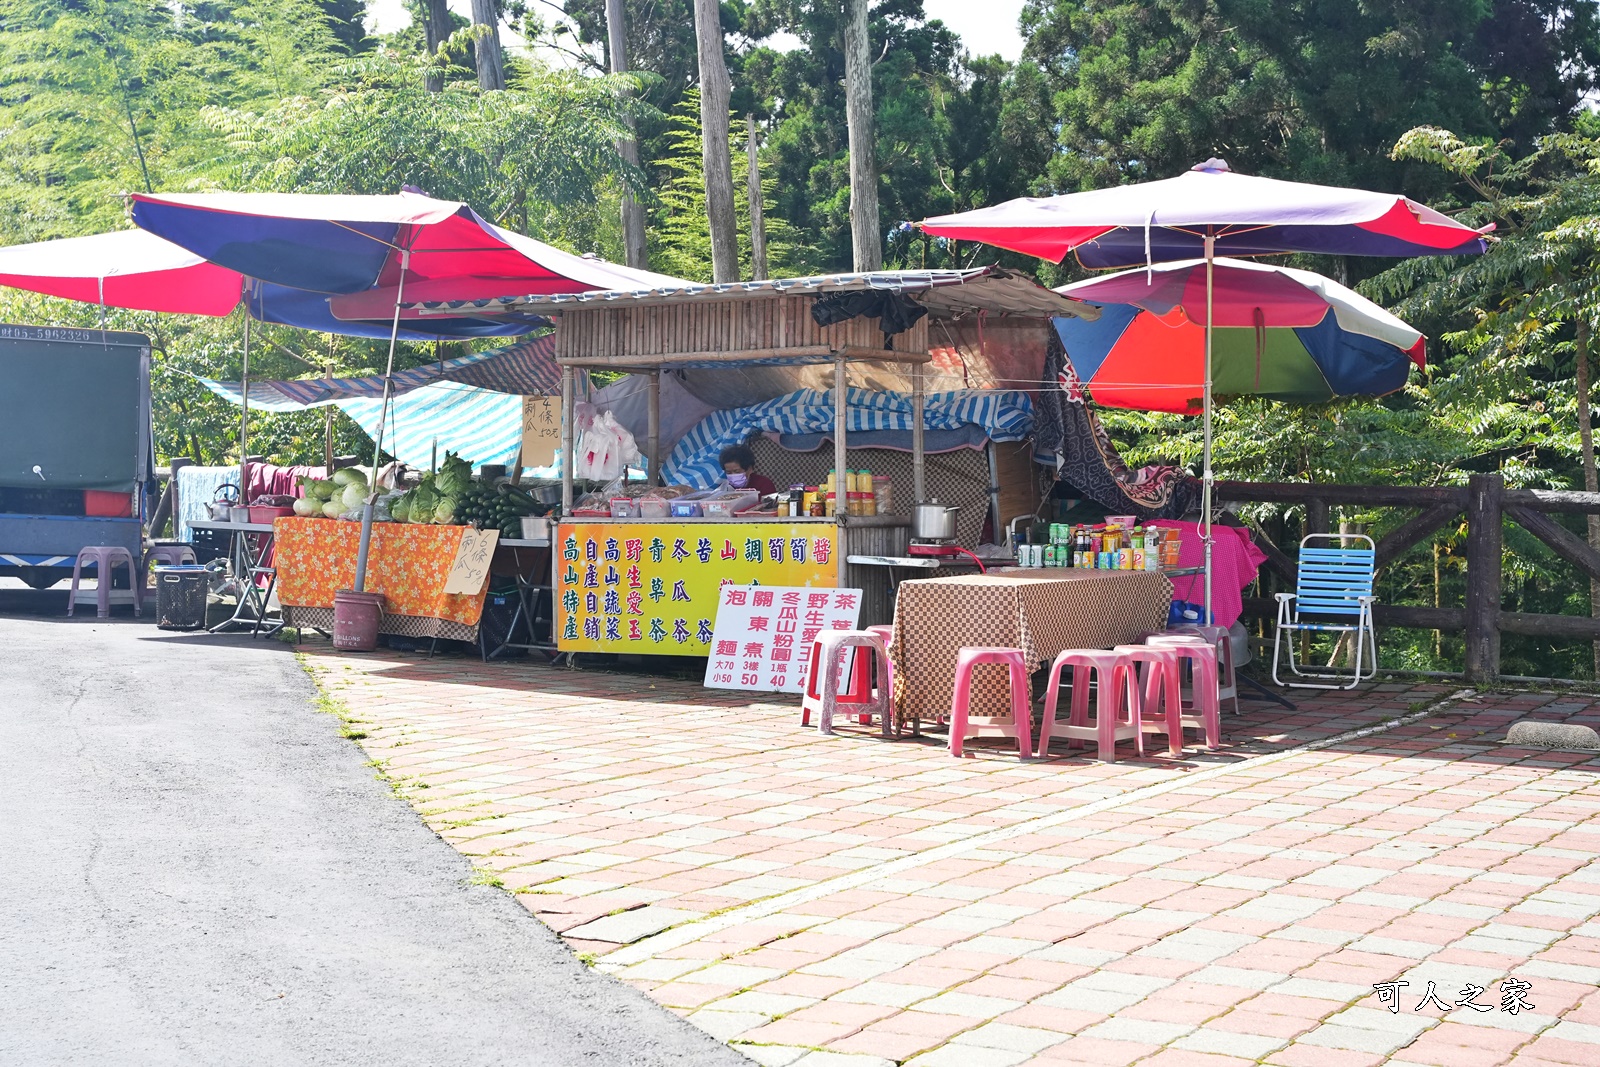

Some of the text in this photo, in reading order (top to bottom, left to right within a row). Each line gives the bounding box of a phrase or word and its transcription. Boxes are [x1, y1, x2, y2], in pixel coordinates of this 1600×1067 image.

[562, 538, 580, 639] 高山特產
[583, 539, 601, 639] 自產自銷
[604, 538, 622, 639] 高山蔬菜
[625, 539, 643, 640] 野生愛玉
[648, 538, 667, 642] 青草茶
[671, 539, 691, 643] 冬瓜茶
[771, 592, 801, 661] 冬瓜山粉圓
[741, 674, 758, 685] 50
[770, 675, 785, 687] 40
